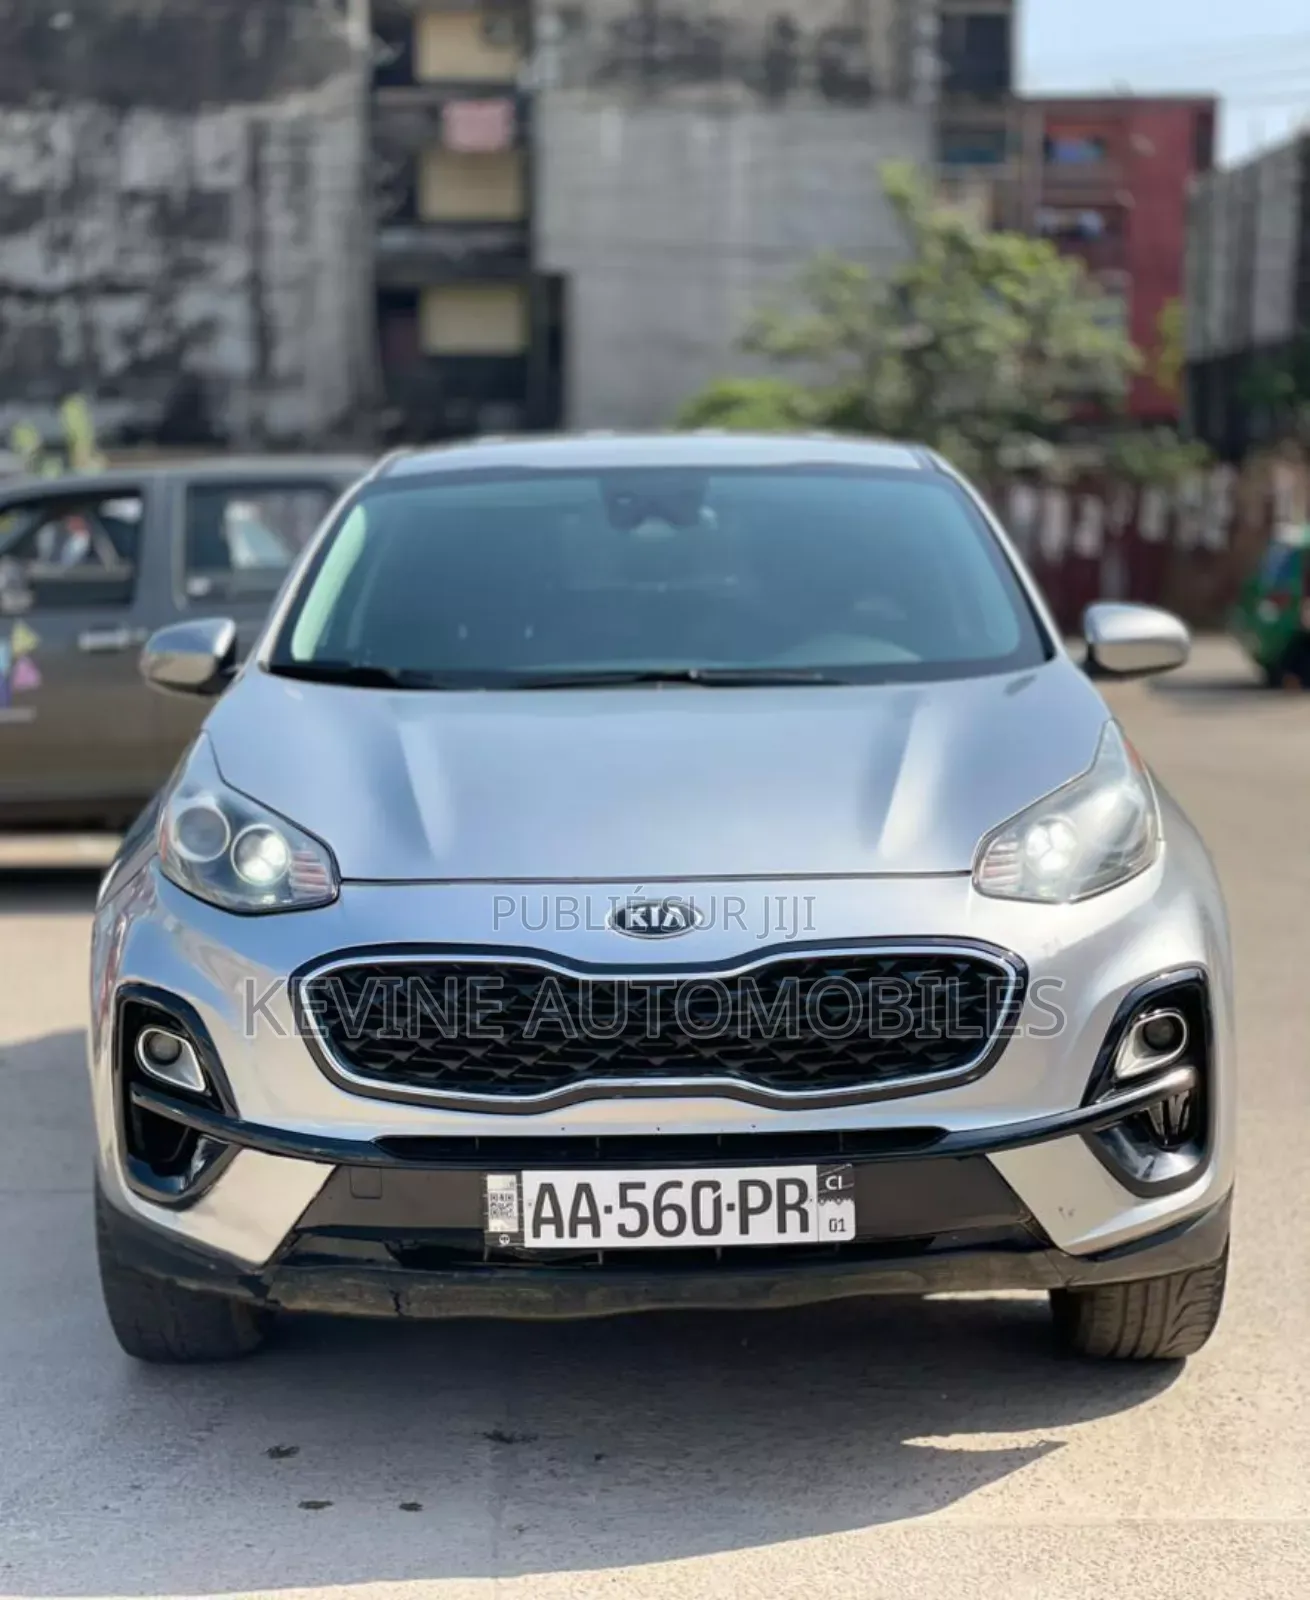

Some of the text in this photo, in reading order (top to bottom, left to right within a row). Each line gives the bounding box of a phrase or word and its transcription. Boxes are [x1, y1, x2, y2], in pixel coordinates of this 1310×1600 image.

[626, 906, 687, 928] KIA
[825, 1175, 844, 1191] CI
[828, 1217, 847, 1233] 01
